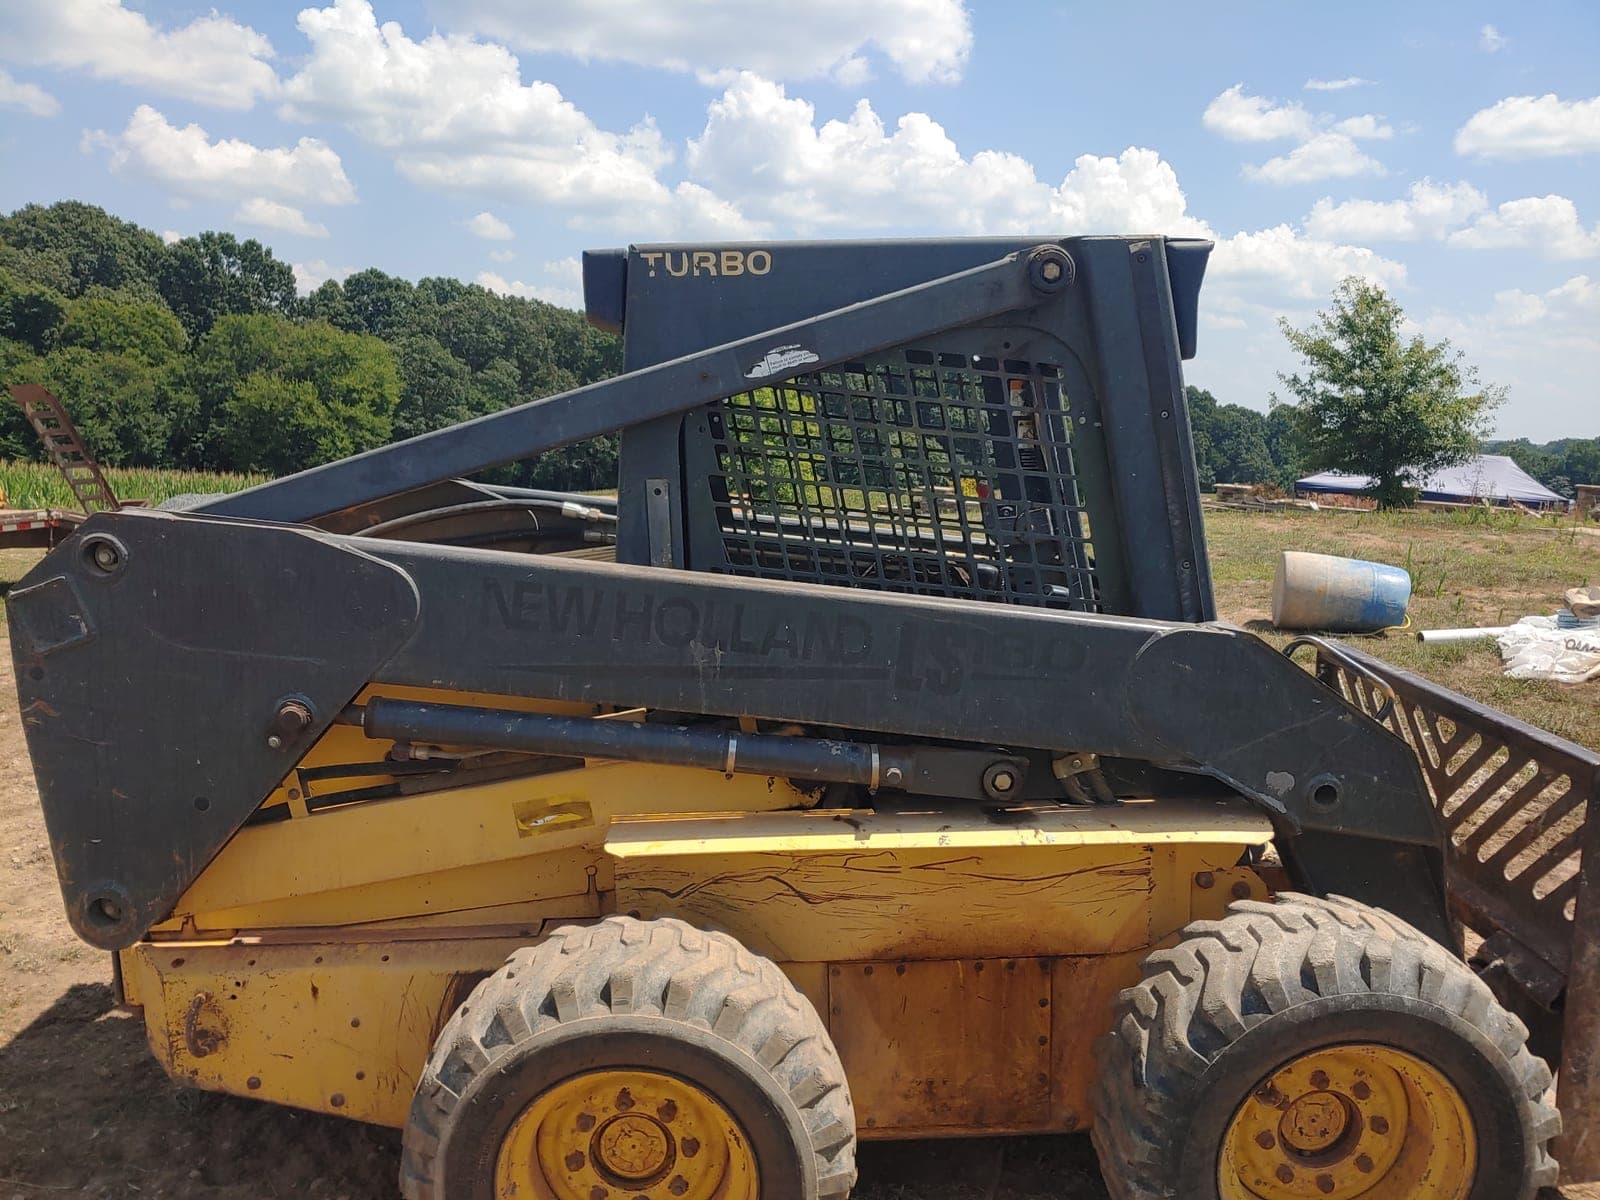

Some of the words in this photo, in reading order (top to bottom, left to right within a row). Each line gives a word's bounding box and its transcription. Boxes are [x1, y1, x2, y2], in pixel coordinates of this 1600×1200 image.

[640, 250, 772, 277] TURBO
[482, 577, 604, 637] NEW
[613, 593, 873, 664] HOLLAND
